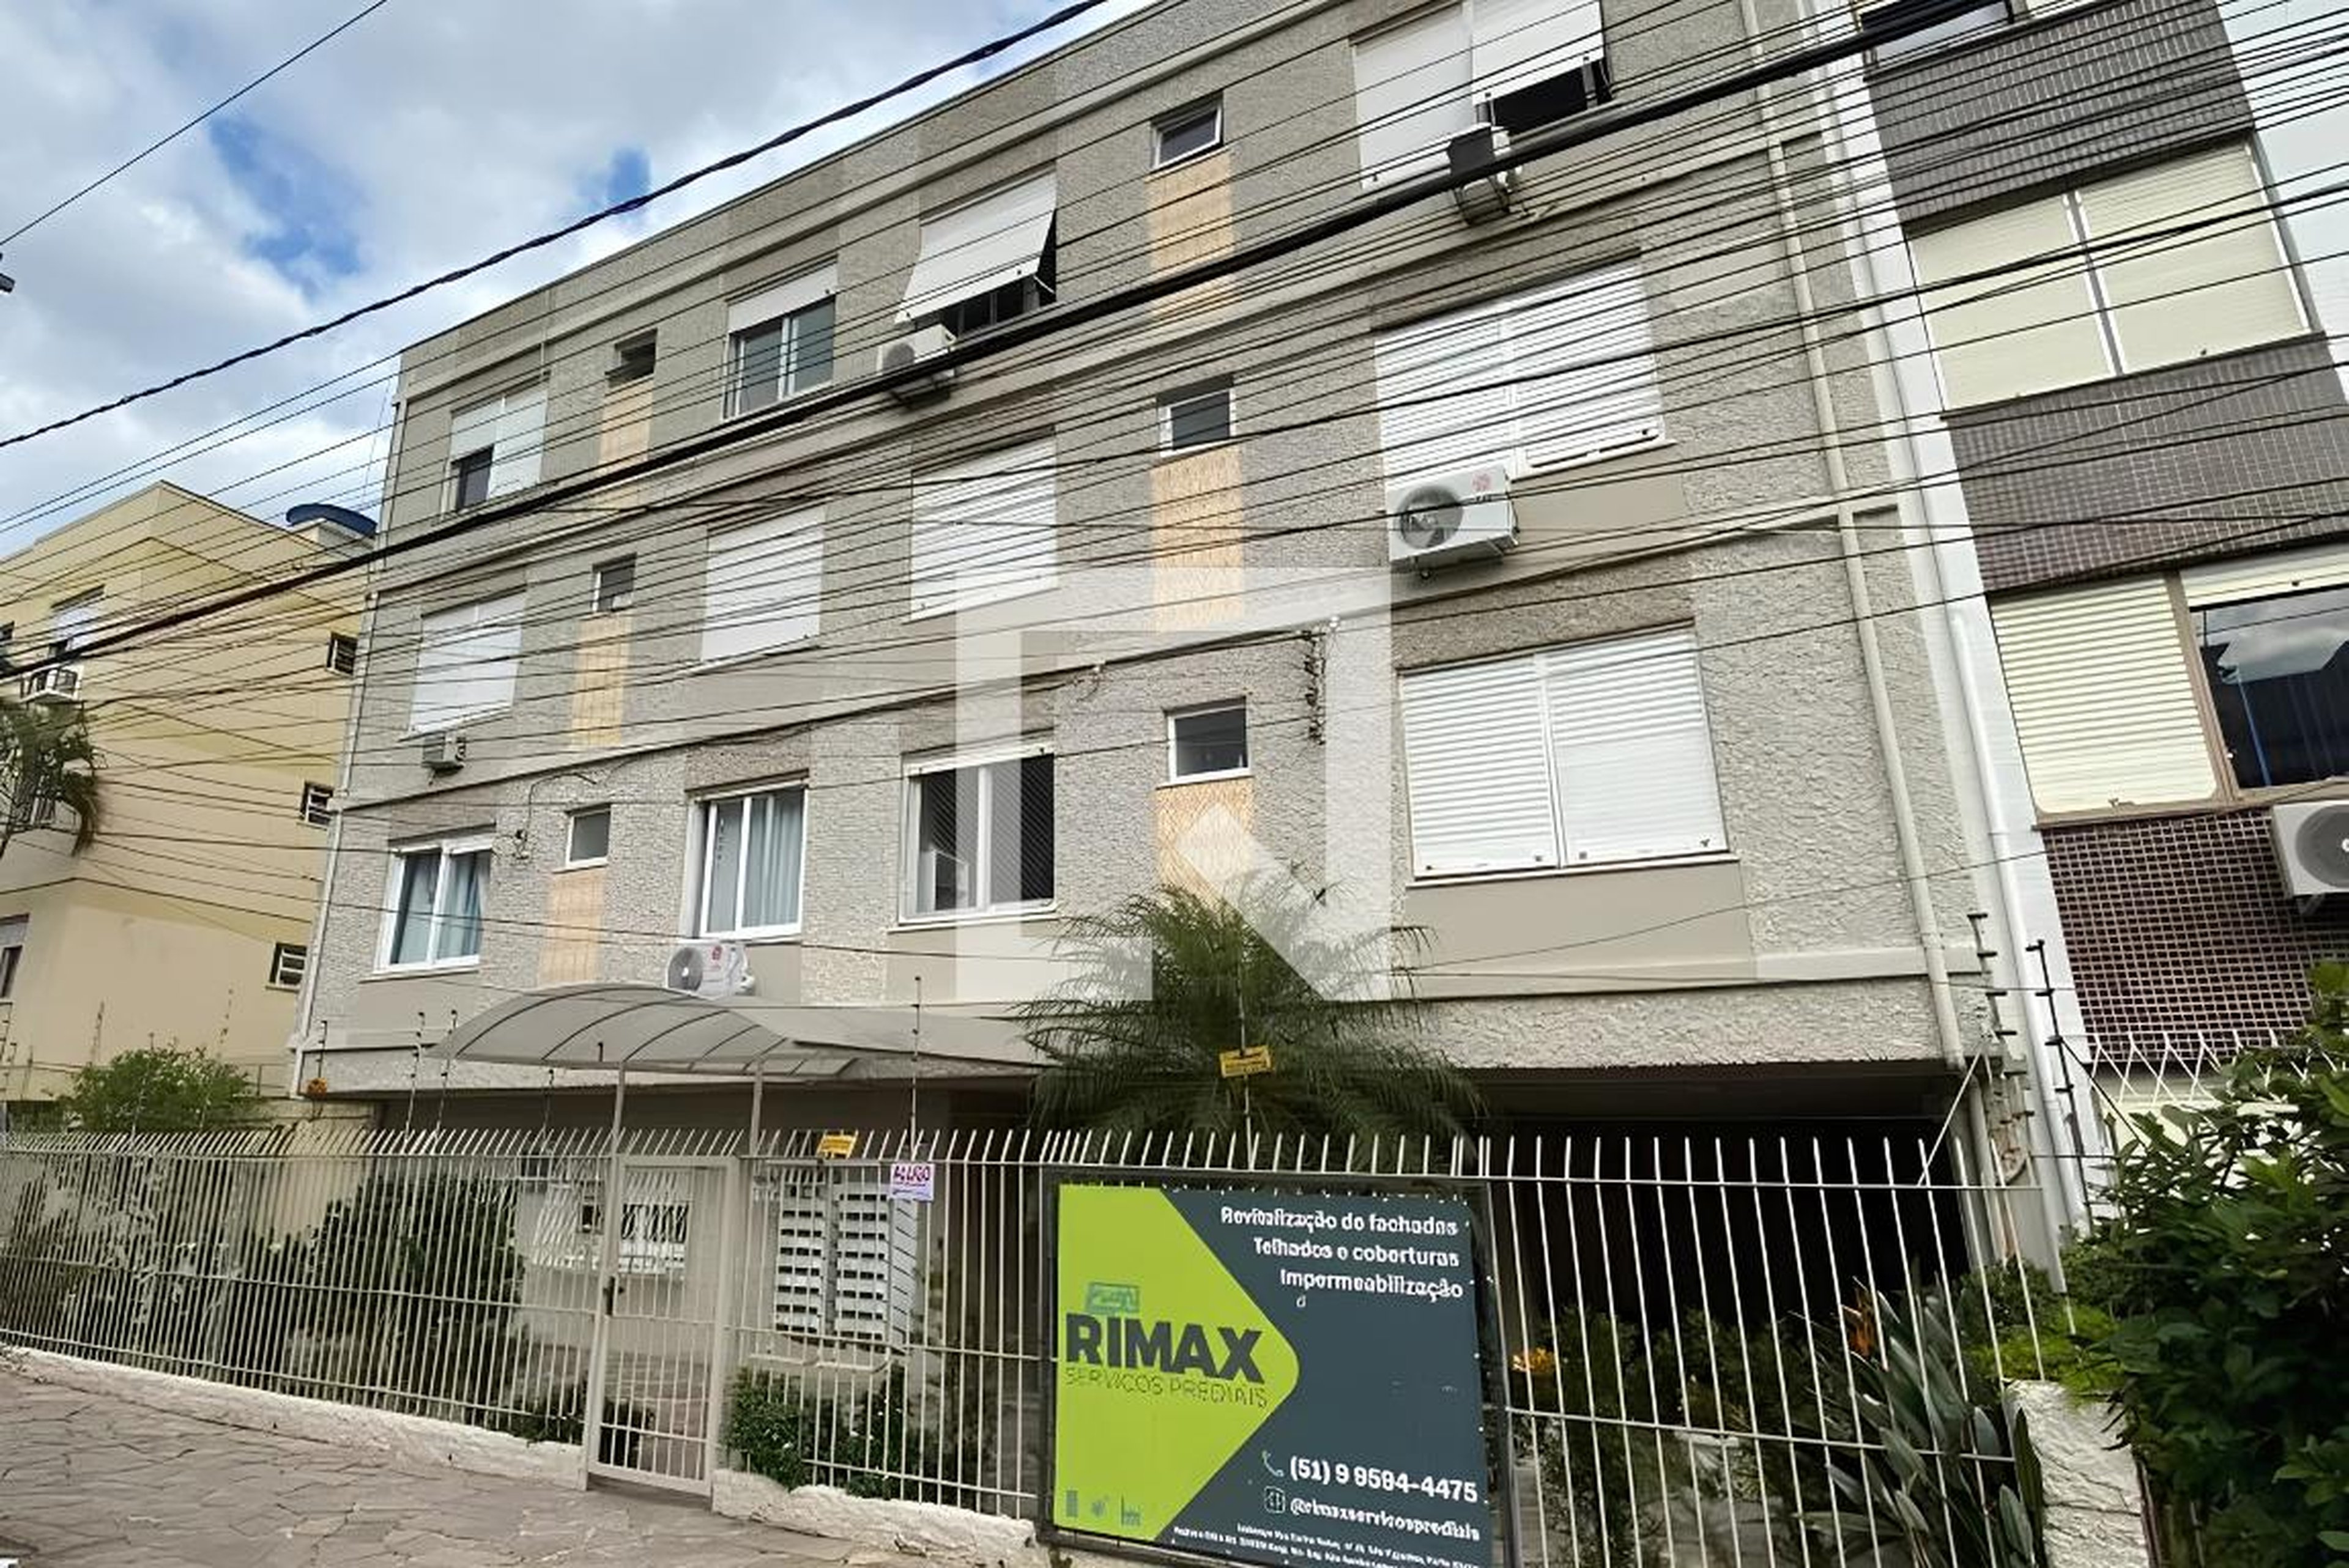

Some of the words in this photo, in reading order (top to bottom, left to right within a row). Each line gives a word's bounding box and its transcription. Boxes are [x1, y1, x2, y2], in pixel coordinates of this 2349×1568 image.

[1066, 1312, 1266, 1385] RIMAX
[1290, 1455, 1331, 1485] (51)
[1334, 1463, 1349, 1485] 9
